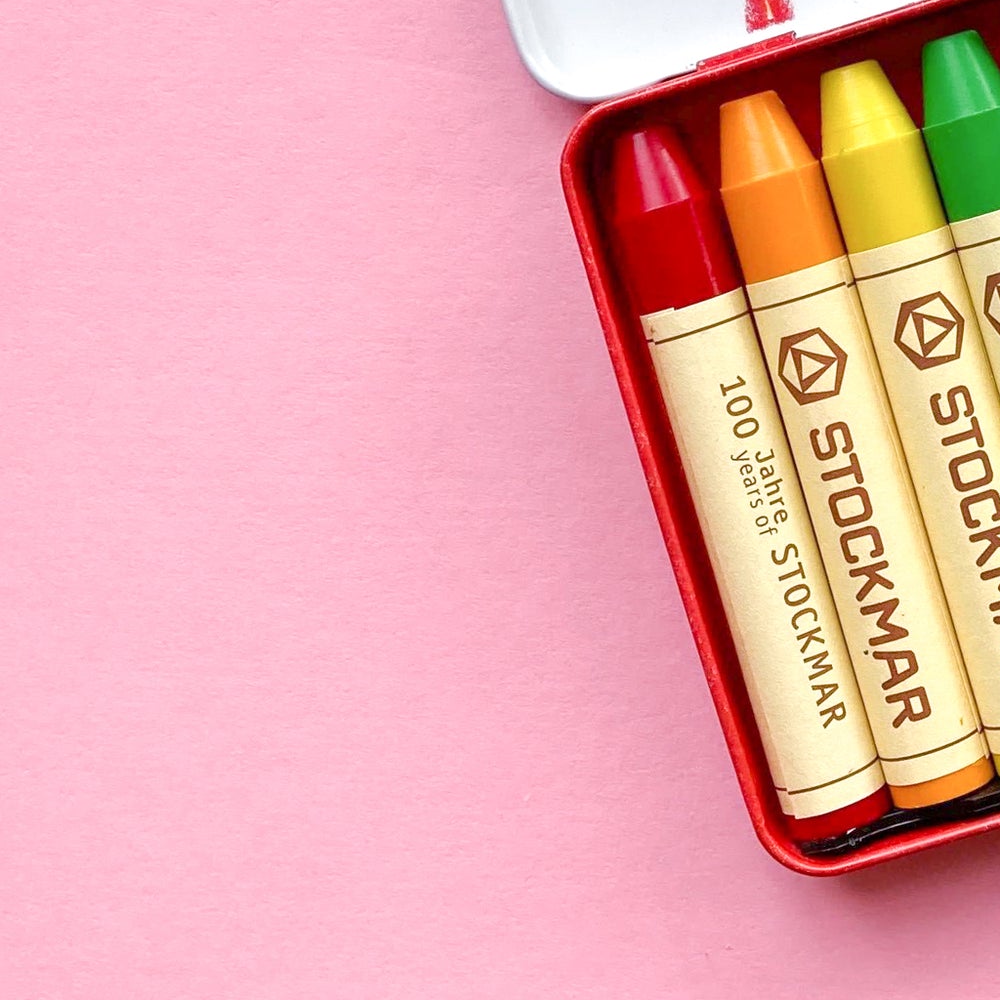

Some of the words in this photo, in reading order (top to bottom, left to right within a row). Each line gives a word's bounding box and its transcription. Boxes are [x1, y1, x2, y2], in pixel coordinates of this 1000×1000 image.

[719, 375, 760, 440] 100
[729, 449, 764, 508] years
[755, 514, 778, 537] of
[755, 448, 789, 526] Jahre
[809, 421, 932, 729] STOCKMAR
[771, 542, 848, 729] STOCKMAR
